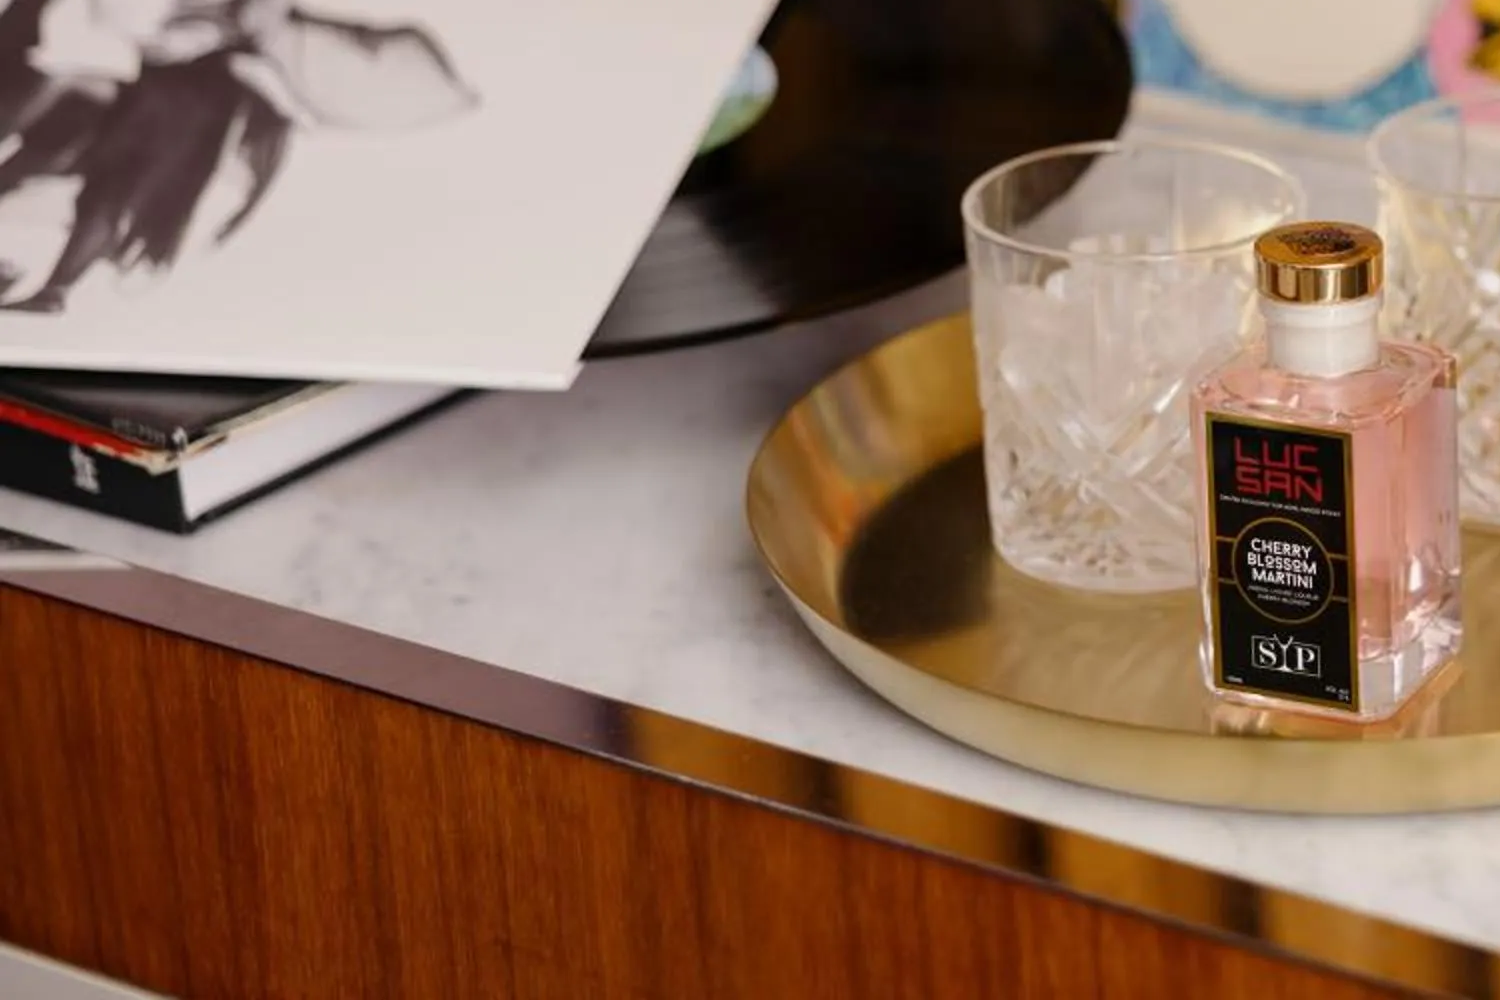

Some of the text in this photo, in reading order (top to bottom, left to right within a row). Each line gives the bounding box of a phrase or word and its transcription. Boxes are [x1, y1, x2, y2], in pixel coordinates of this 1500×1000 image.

[1234, 436, 1319, 473] LUC
[1236, 466, 1322, 503] SAN
[1251, 538, 1312, 559] CHERRY
[1247, 551, 1317, 575] BLOSSOM
[1252, 567, 1313, 589] MARTINI
